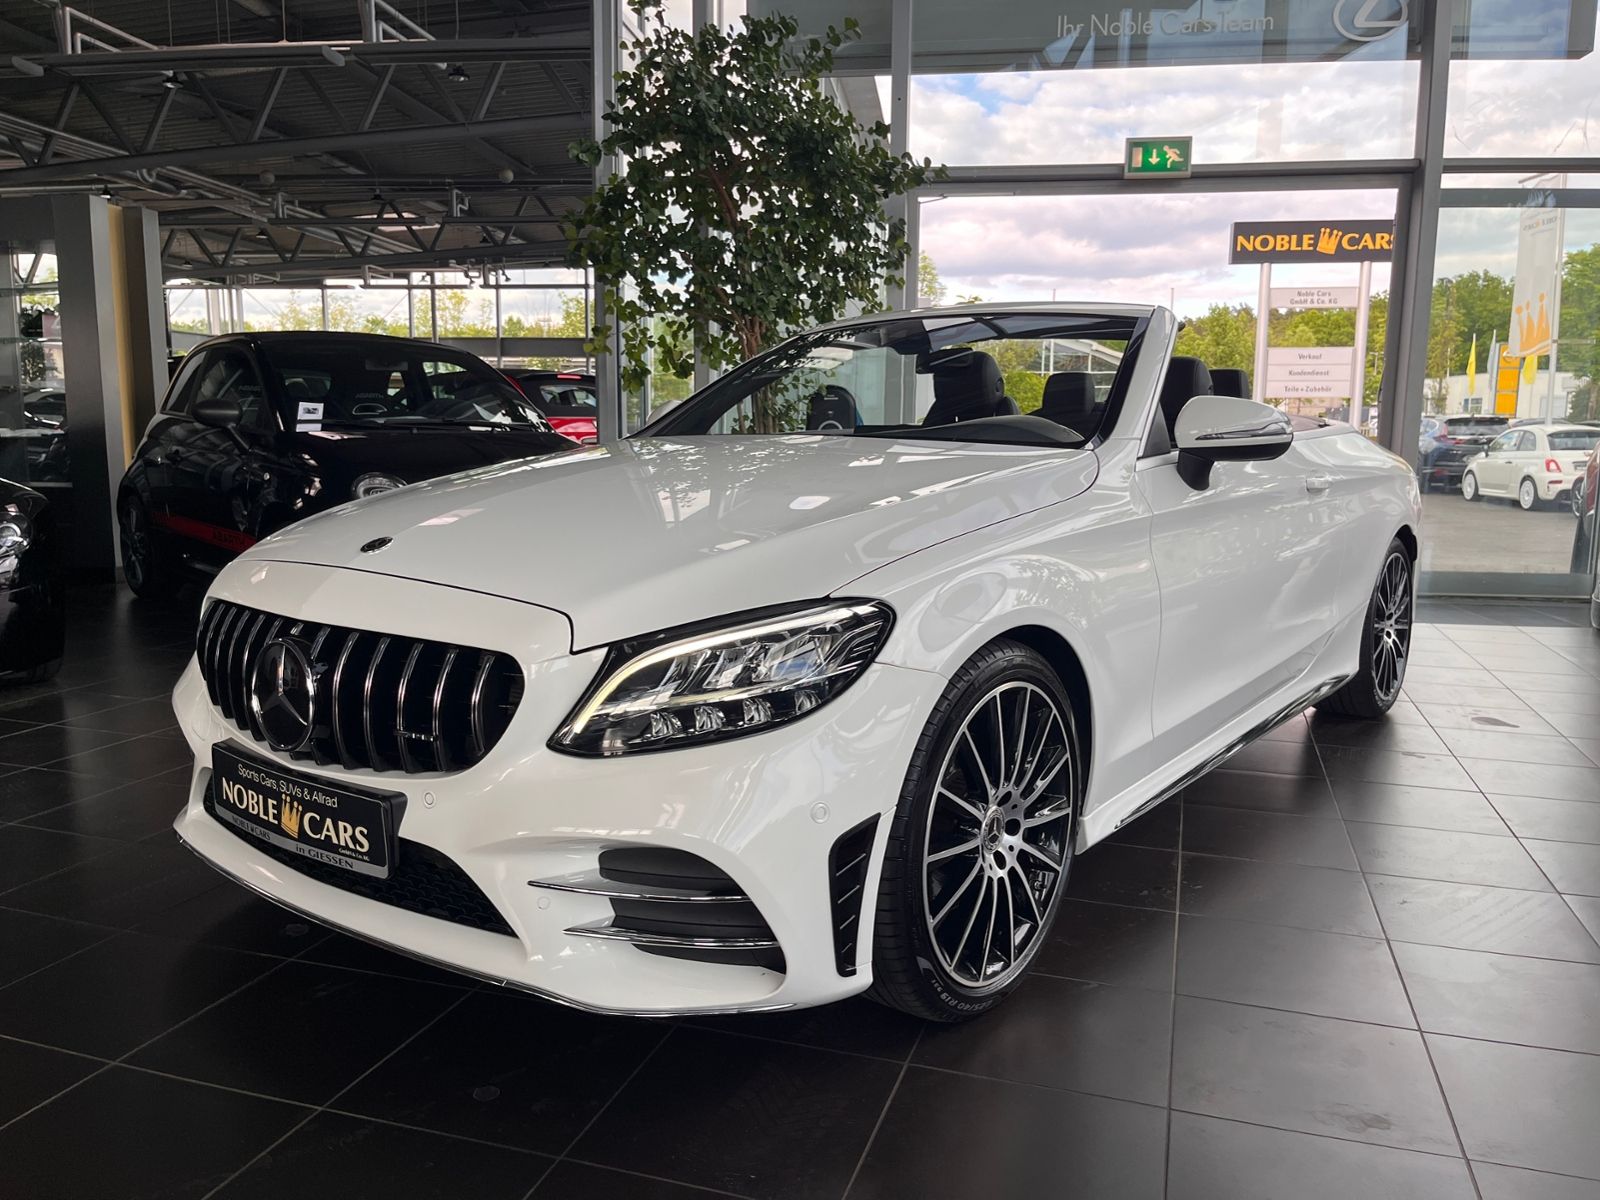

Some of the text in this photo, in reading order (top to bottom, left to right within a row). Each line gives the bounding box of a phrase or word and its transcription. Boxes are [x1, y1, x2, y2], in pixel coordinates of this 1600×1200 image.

[1057, 10, 1275, 38] Ihr Noble Cars Team
[1236, 233, 1315, 252] NOBLE
[238, 763, 260, 783] Sports
[279, 780, 302, 797] SUVs
[303, 787, 311, 800] &
[312, 790, 338, 808] Allrad
[222, 776, 370, 853] NOBLE CARS
[295, 843, 354, 870] in GIESSEN
